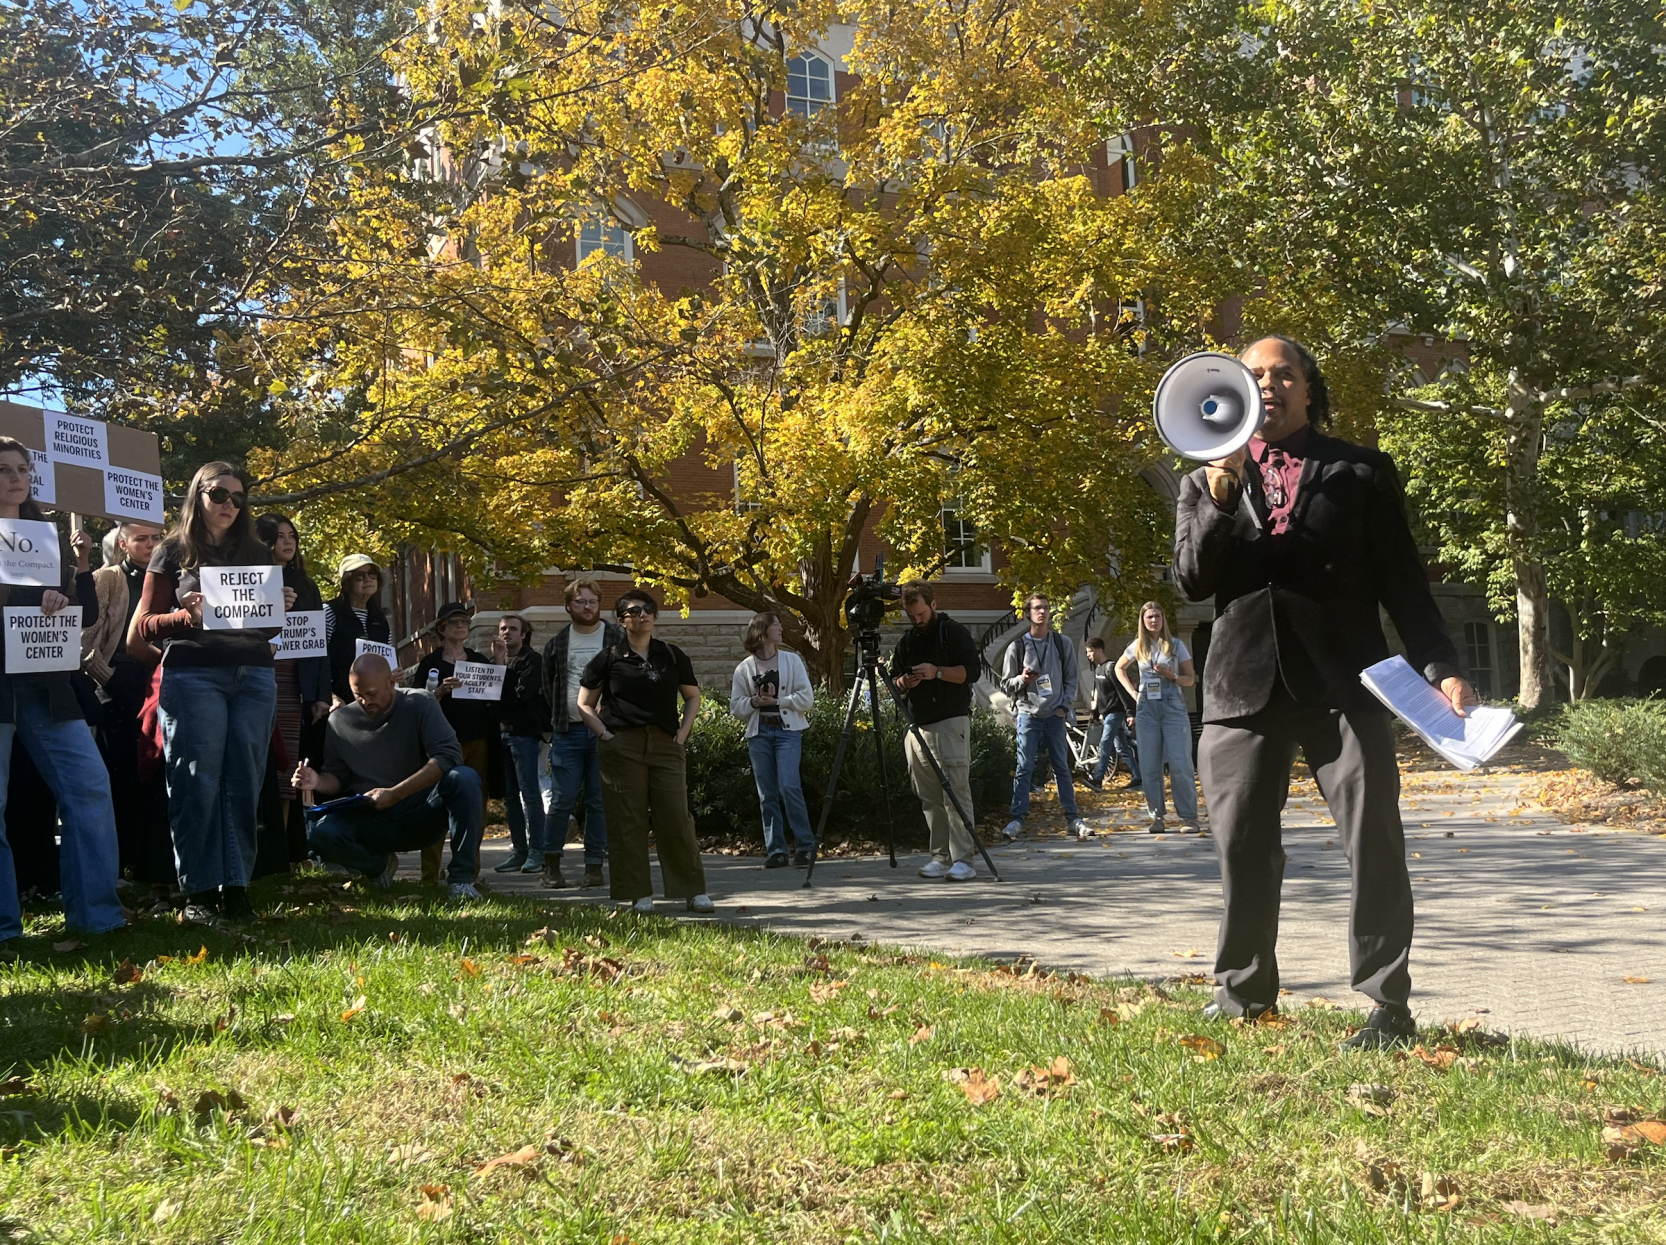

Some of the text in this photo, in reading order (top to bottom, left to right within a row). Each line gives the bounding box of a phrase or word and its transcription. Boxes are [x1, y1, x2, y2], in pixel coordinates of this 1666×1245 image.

[57, 420, 94, 435] PROTECT
[54, 431, 98, 448] RELIGIOUS
[33, 451, 48, 463] THE
[53, 442, 102, 460] MINORITIES
[107, 472, 159, 492] PROTECT THE
[115, 484, 153, 501] WOMEN'S
[120, 497, 150, 512] CENTER
[0, 531, 39, 553] No.
[220, 572, 264, 586] REJECT
[232, 588, 255, 602] THE
[214, 604, 273, 618] COMPACT
[10, 615, 77, 628] PROTECT THE
[286, 616, 308, 626] STOP
[20, 631, 68, 644] WOMEN'S
[280, 628, 316, 639] TRUMP'S
[303, 639, 325, 650] GRAB
[362, 643, 392, 657] PROTECT
[26, 646, 63, 659] CENTER
[456, 672, 471, 680] YOUR
[465, 666, 485, 674] LISTEN
